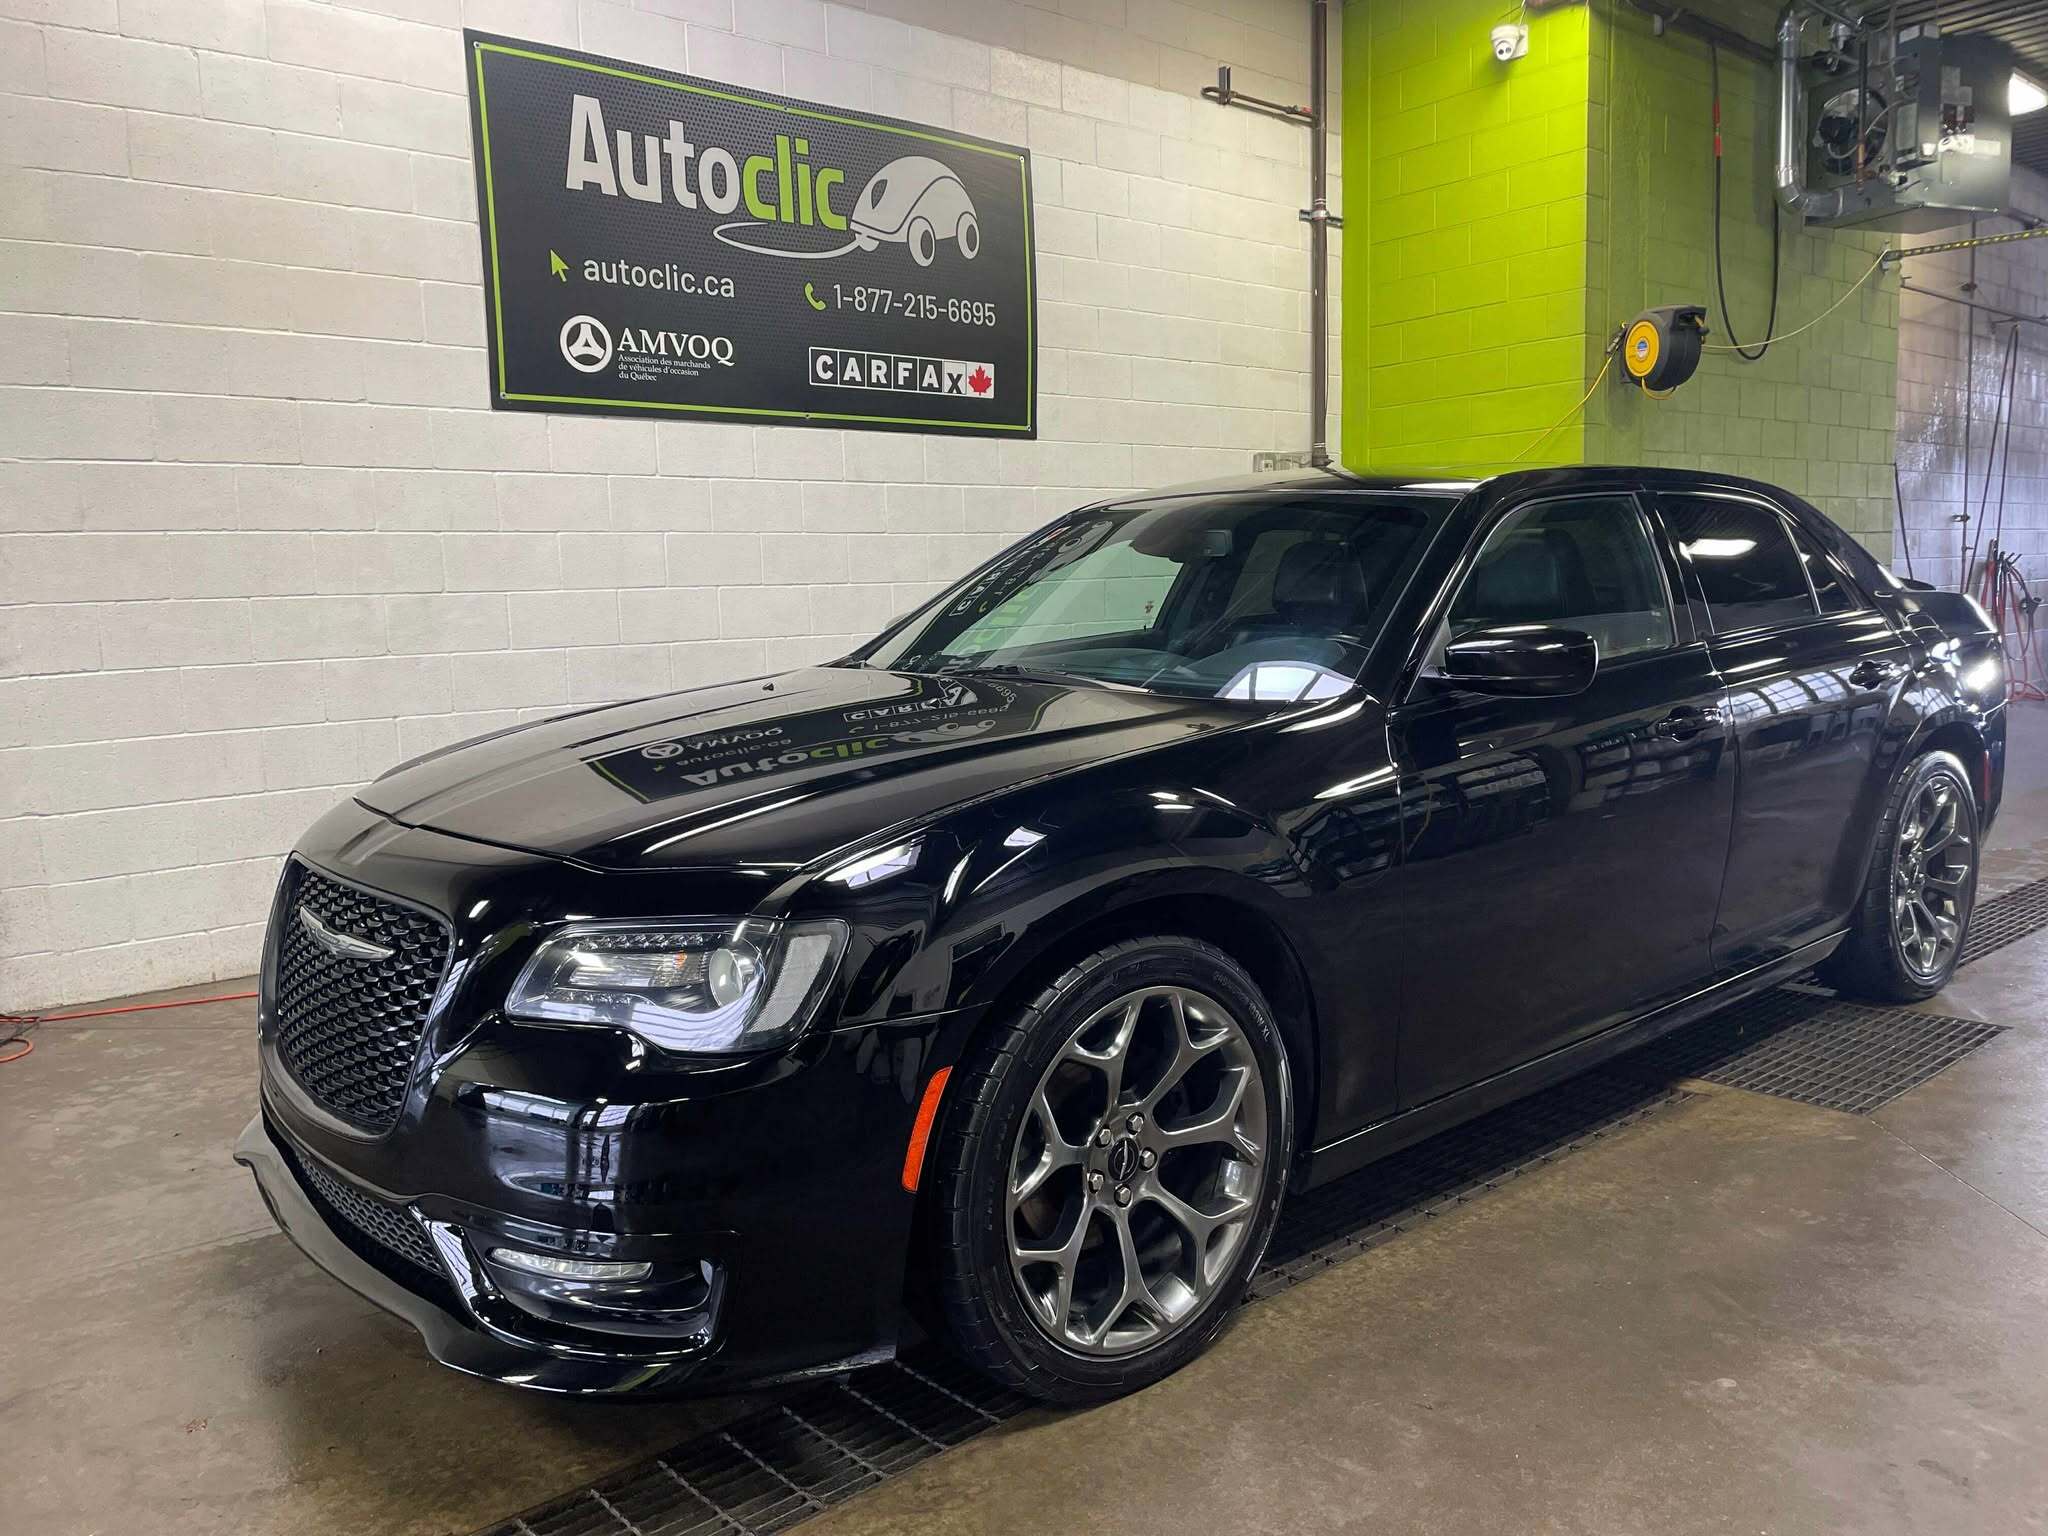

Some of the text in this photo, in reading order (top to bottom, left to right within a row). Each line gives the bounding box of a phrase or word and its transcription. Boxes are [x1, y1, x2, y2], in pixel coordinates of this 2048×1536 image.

[566, 94, 847, 231] Autoclic
[583, 258, 735, 298] autoclic.ca
[833, 284, 996, 327] 1-877-215-6695
[617, 327, 735, 367] AMVOQ
[618, 354, 711, 369] Association des marchands
[618, 362, 628, 370] de
[629, 363, 662, 373] véhicules
[618, 371, 657, 381] du Québec
[815, 353, 963, 395] CARFAX
